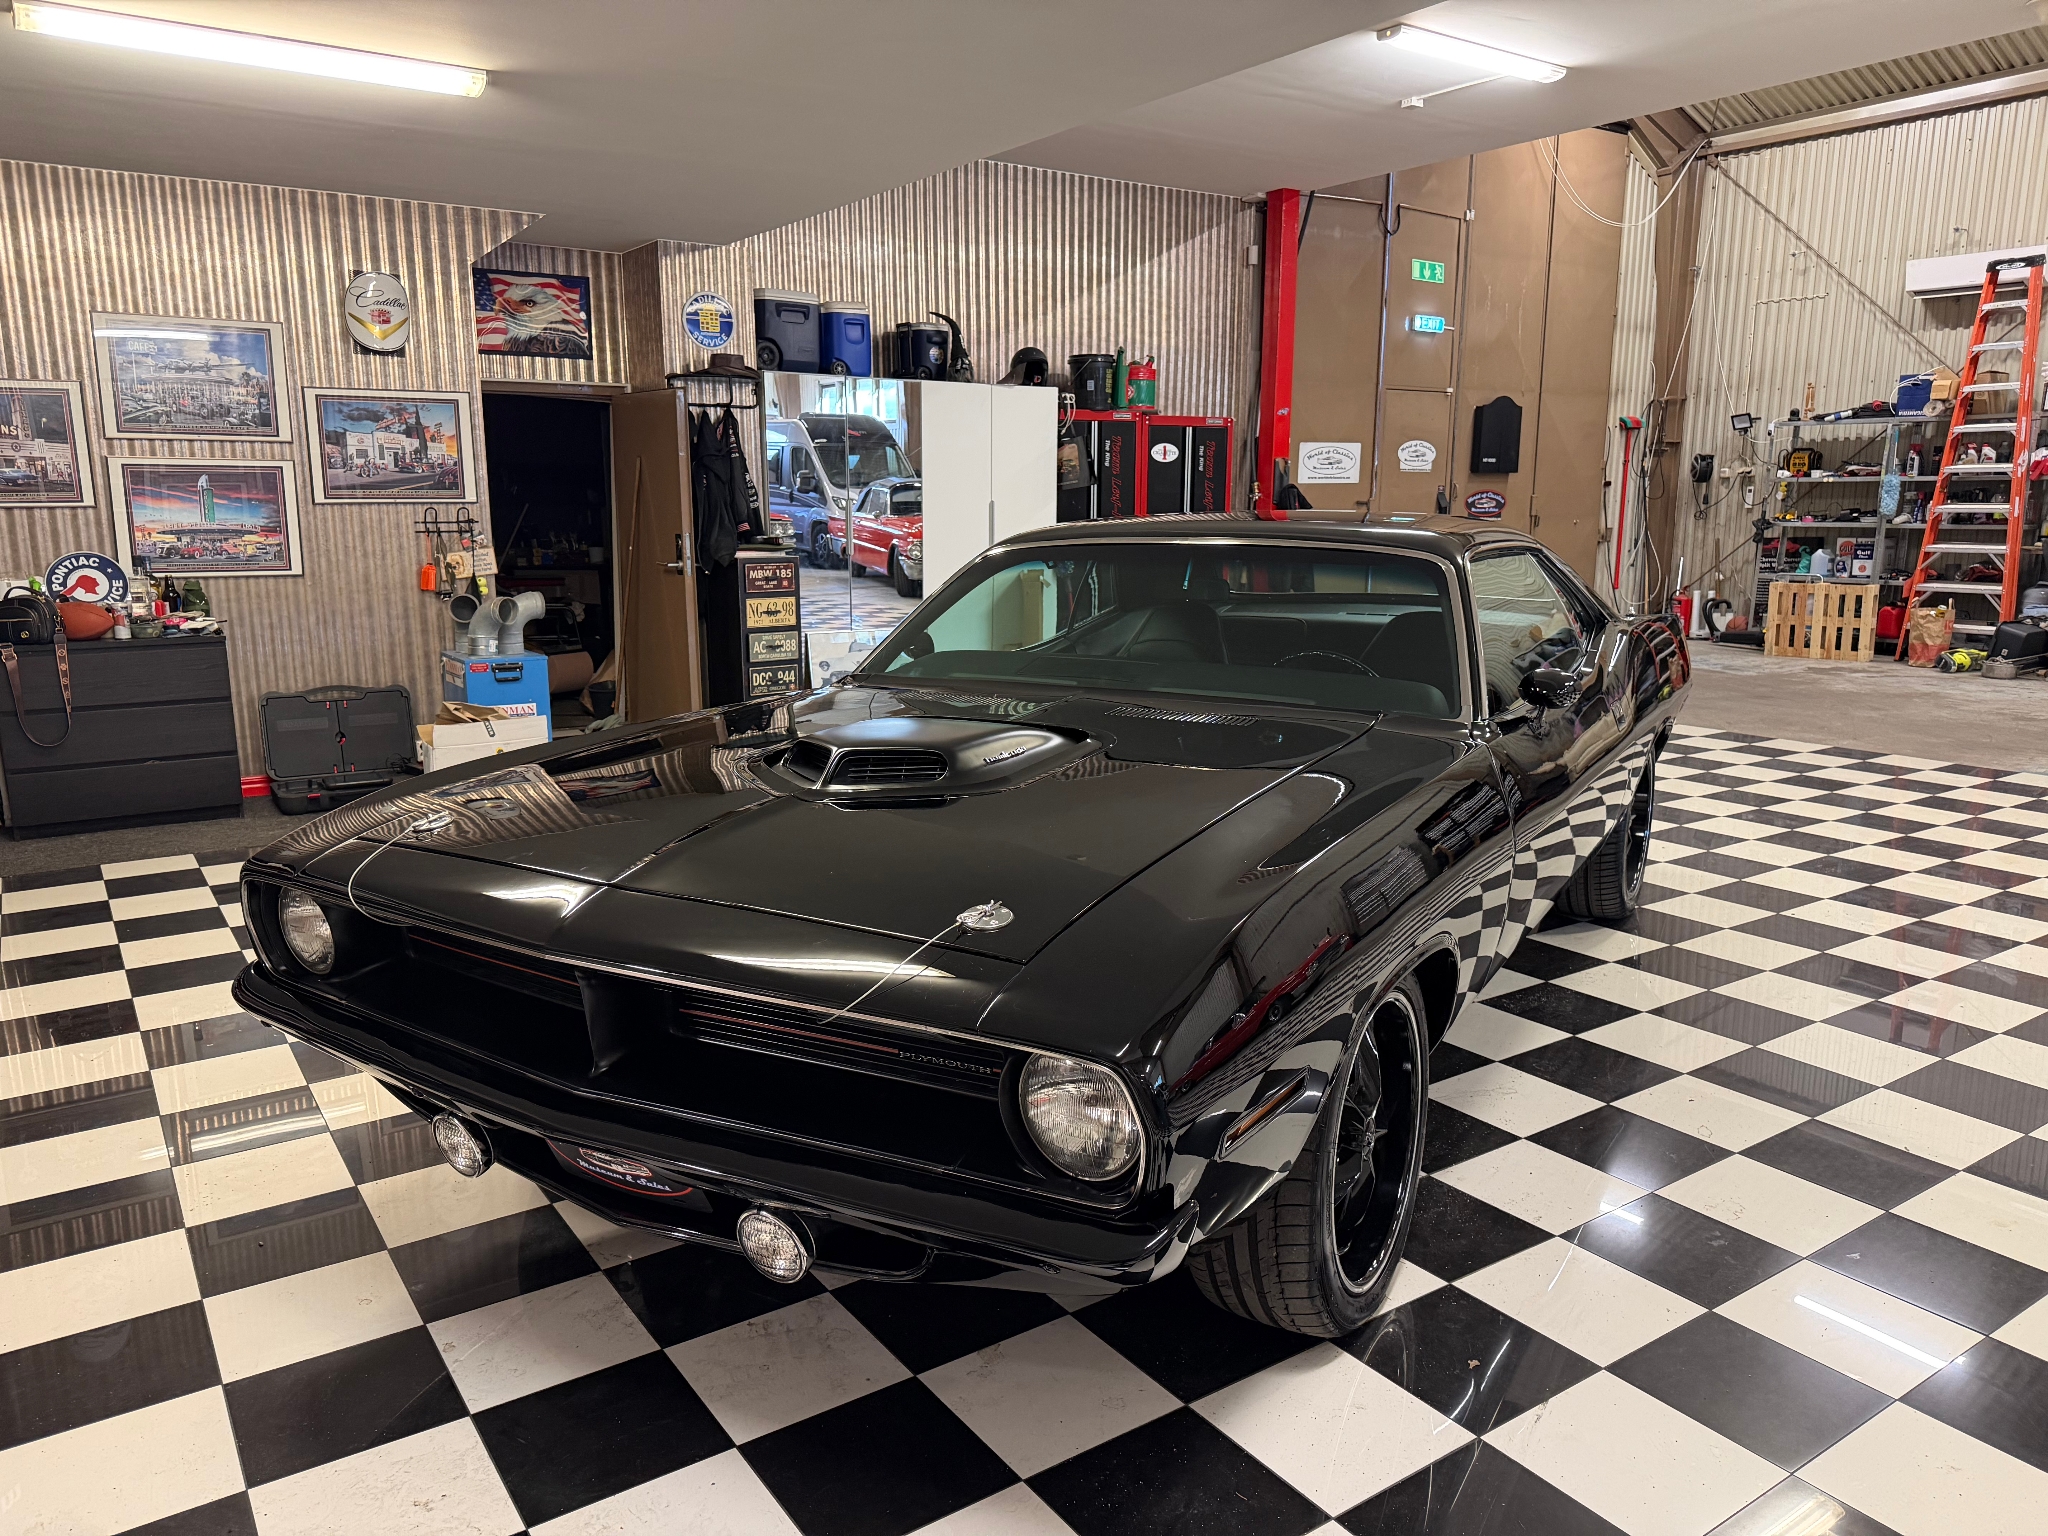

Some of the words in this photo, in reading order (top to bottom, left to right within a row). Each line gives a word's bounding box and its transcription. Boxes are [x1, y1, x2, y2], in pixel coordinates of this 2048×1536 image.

[349, 286, 407, 310] Cadillac
[1422, 317, 1440, 330] EXIT
[693, 331, 728, 346] SERVICE
[1307, 449, 1324, 460] World
[1332, 449, 1353, 461] Classics
[51, 556, 100, 592] PONTIAC
[749, 570, 772, 579] MBW
[775, 569, 792, 578] 185
[753, 641, 767, 654] AC
[899, 1051, 993, 1074] PLYMOUTH
[577, 1158, 624, 1180] Museum
[625, 1174, 635, 1183] &
[636, 1178, 672, 1192] Sales
